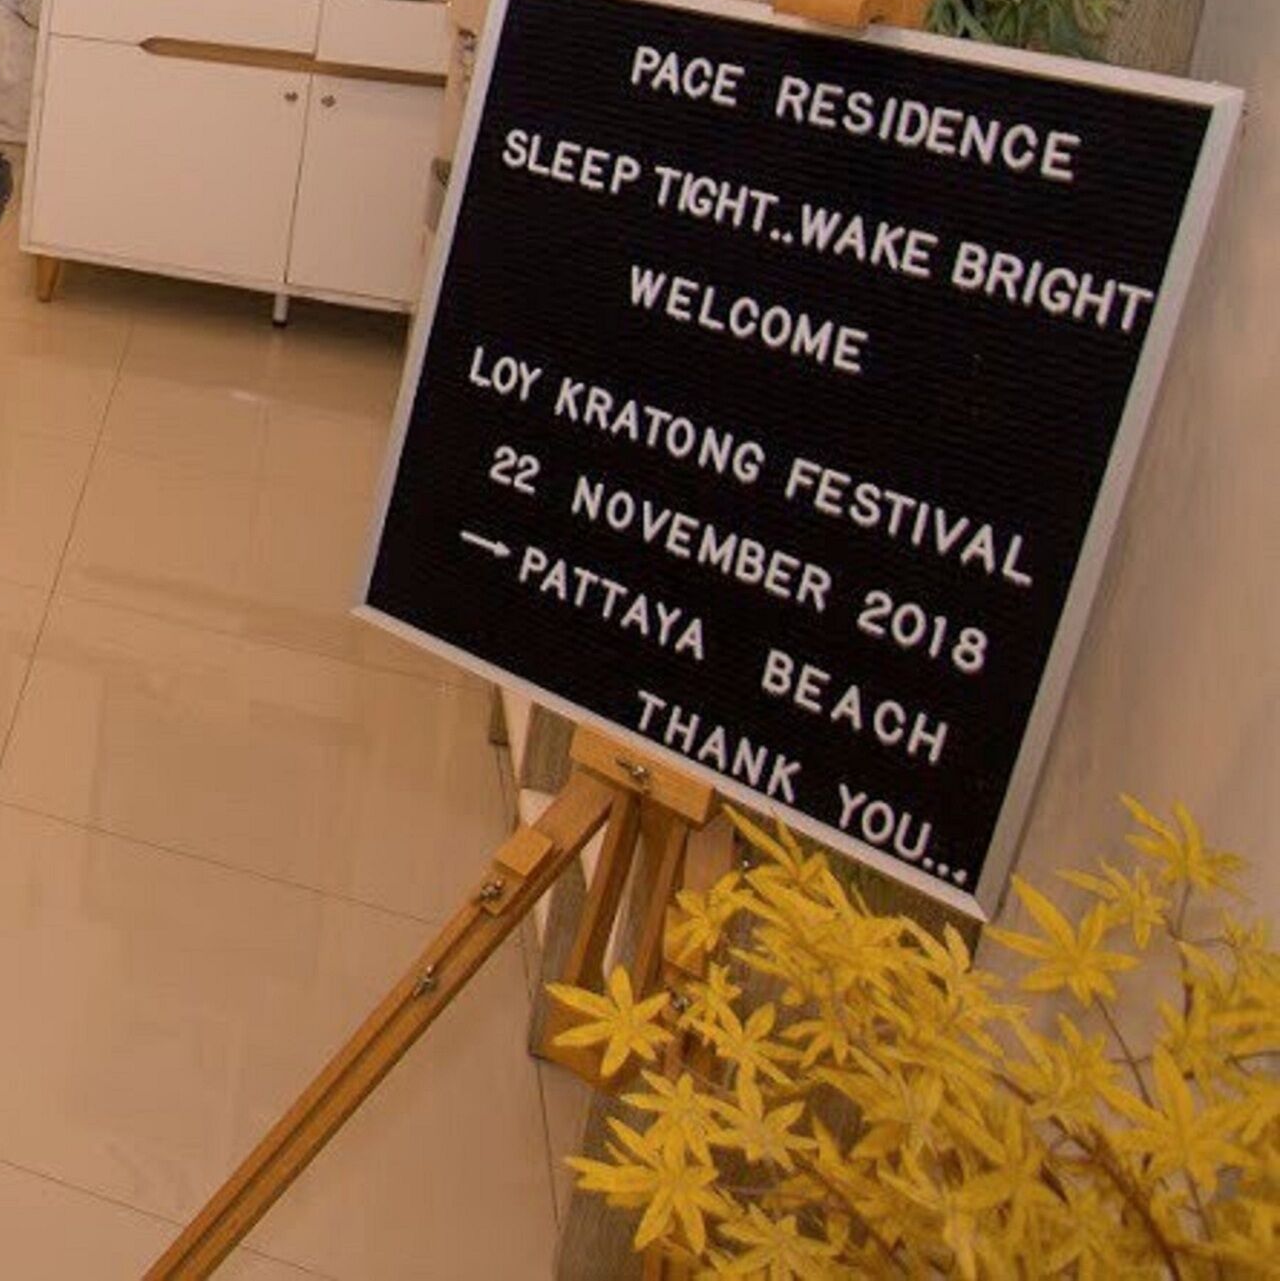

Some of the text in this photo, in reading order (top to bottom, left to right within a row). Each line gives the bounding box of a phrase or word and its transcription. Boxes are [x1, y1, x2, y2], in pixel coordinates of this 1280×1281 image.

[630, 46, 1082, 181] PACE RESIDENCE
[502, 129, 641, 194] SLEEP
[951, 242, 1154, 333] BRIGHT
[630, 265, 868, 373] WELCOME
[469, 346, 1034, 585] LOY KRATONG FESTIVAL
[490, 446, 989, 673] 22 NOVEMBER 2018
[519, 546, 948, 764] PATTAYA BEACH
[637, 689, 801, 805] THANK
